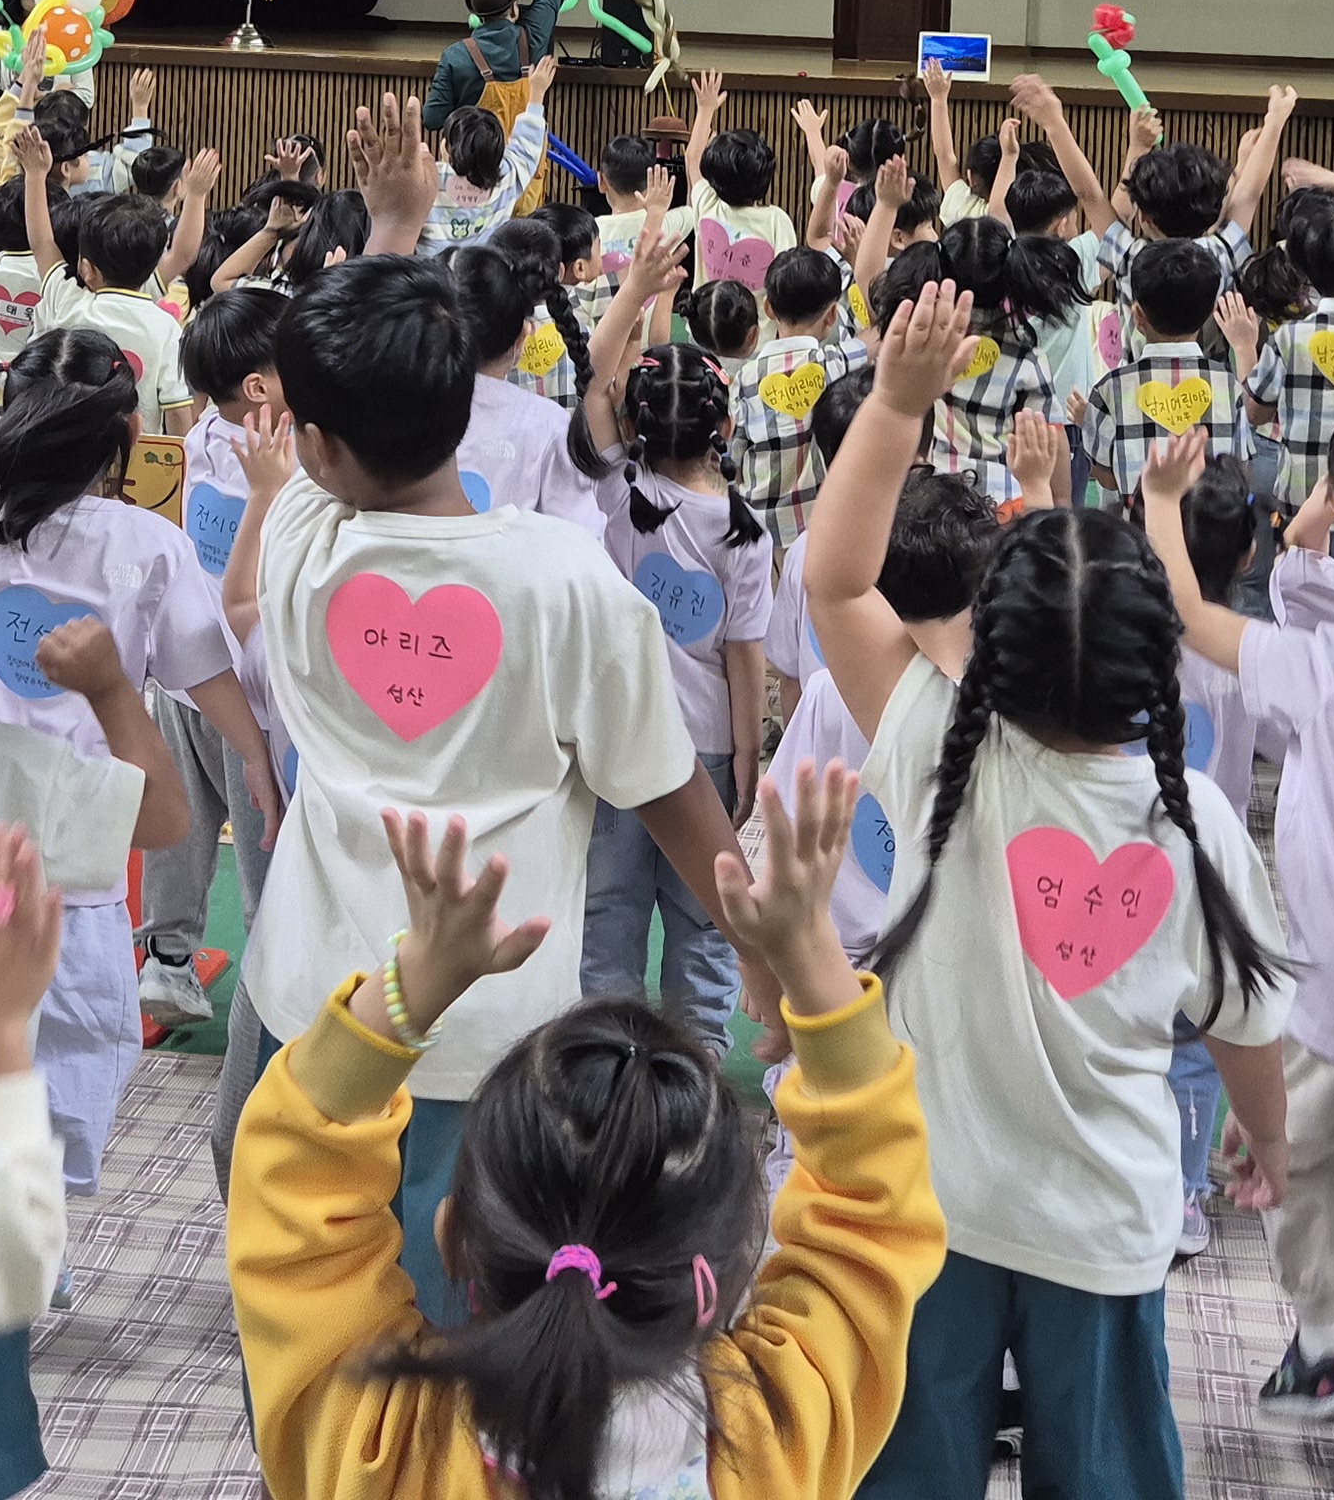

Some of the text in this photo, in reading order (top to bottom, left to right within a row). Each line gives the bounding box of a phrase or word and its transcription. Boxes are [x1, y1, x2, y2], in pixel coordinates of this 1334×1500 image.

[765, 372, 824, 406] 남지어린이집
[1144, 390, 1208, 417] 남지어린이집
[651, 571, 705, 617] 김유진
[363, 627, 454, 661] 아리즈
[1036, 875, 1141, 920] 엄수인
